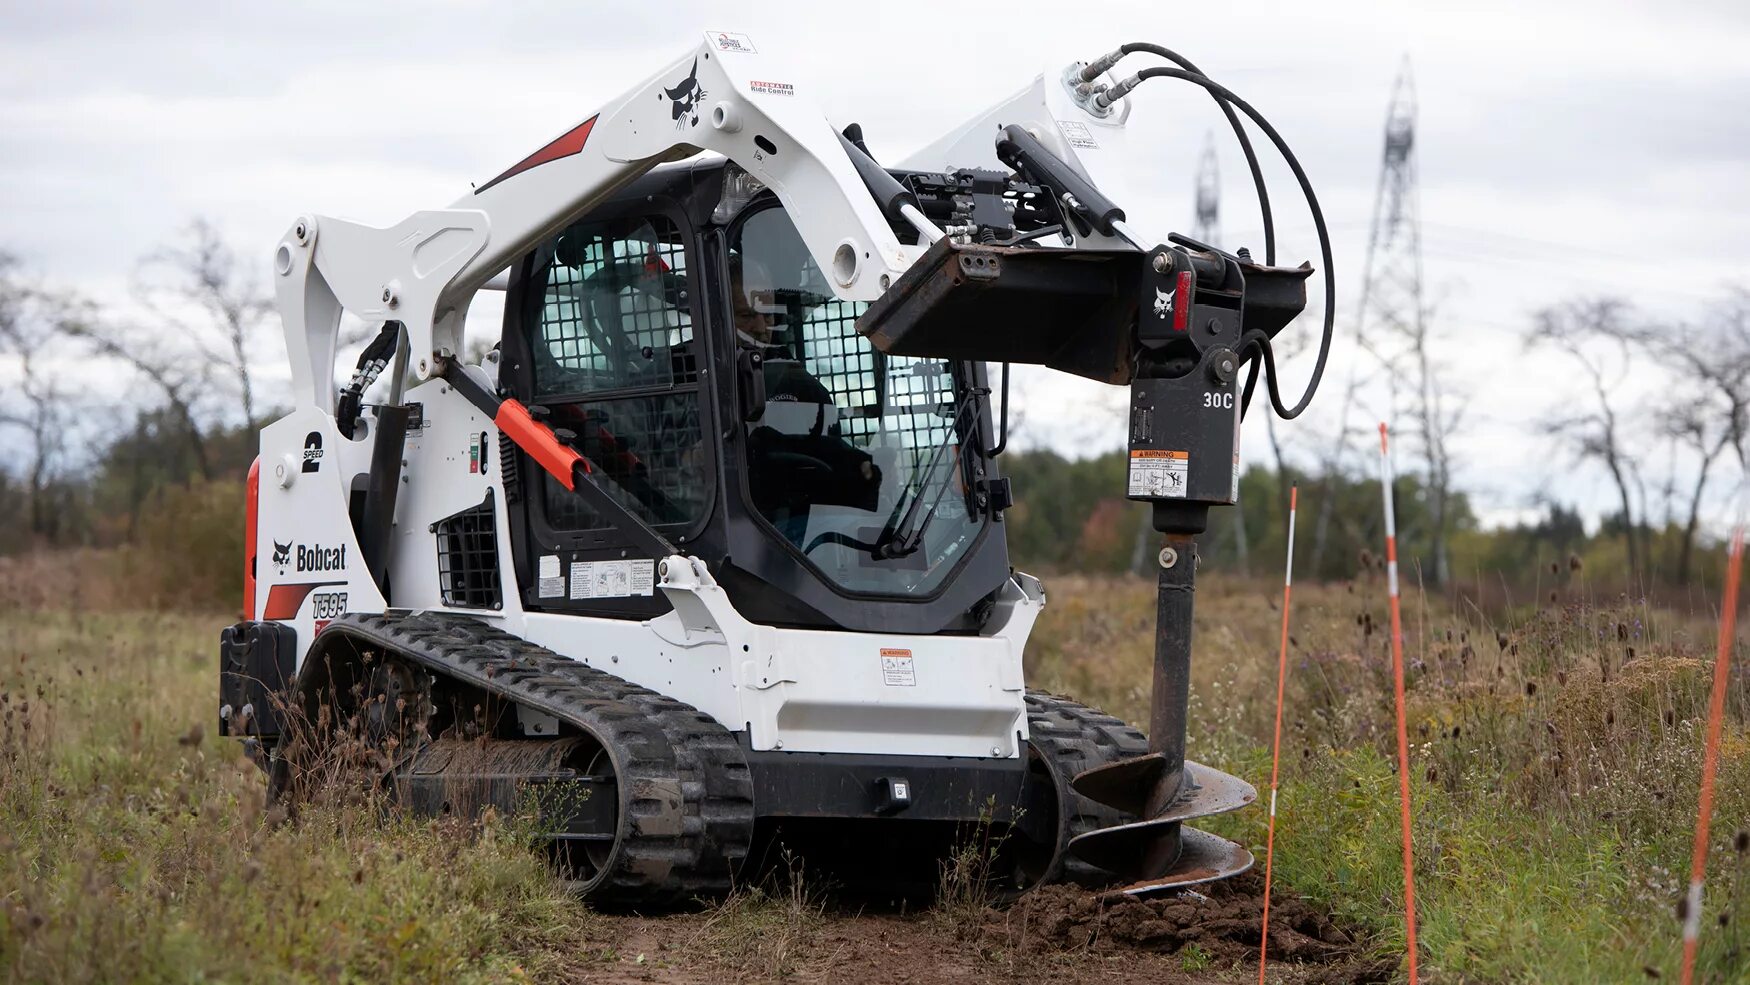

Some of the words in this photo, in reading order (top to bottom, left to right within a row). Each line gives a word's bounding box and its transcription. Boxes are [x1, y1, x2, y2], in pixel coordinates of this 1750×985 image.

[751, 81, 793, 89] AUTOMATIC
[1203, 391, 1233, 409] 30C
[301, 431, 322, 473] 2
[303, 449, 324, 459] SPEED
[296, 543, 346, 572] Bobcat
[312, 592, 348, 619] T595
